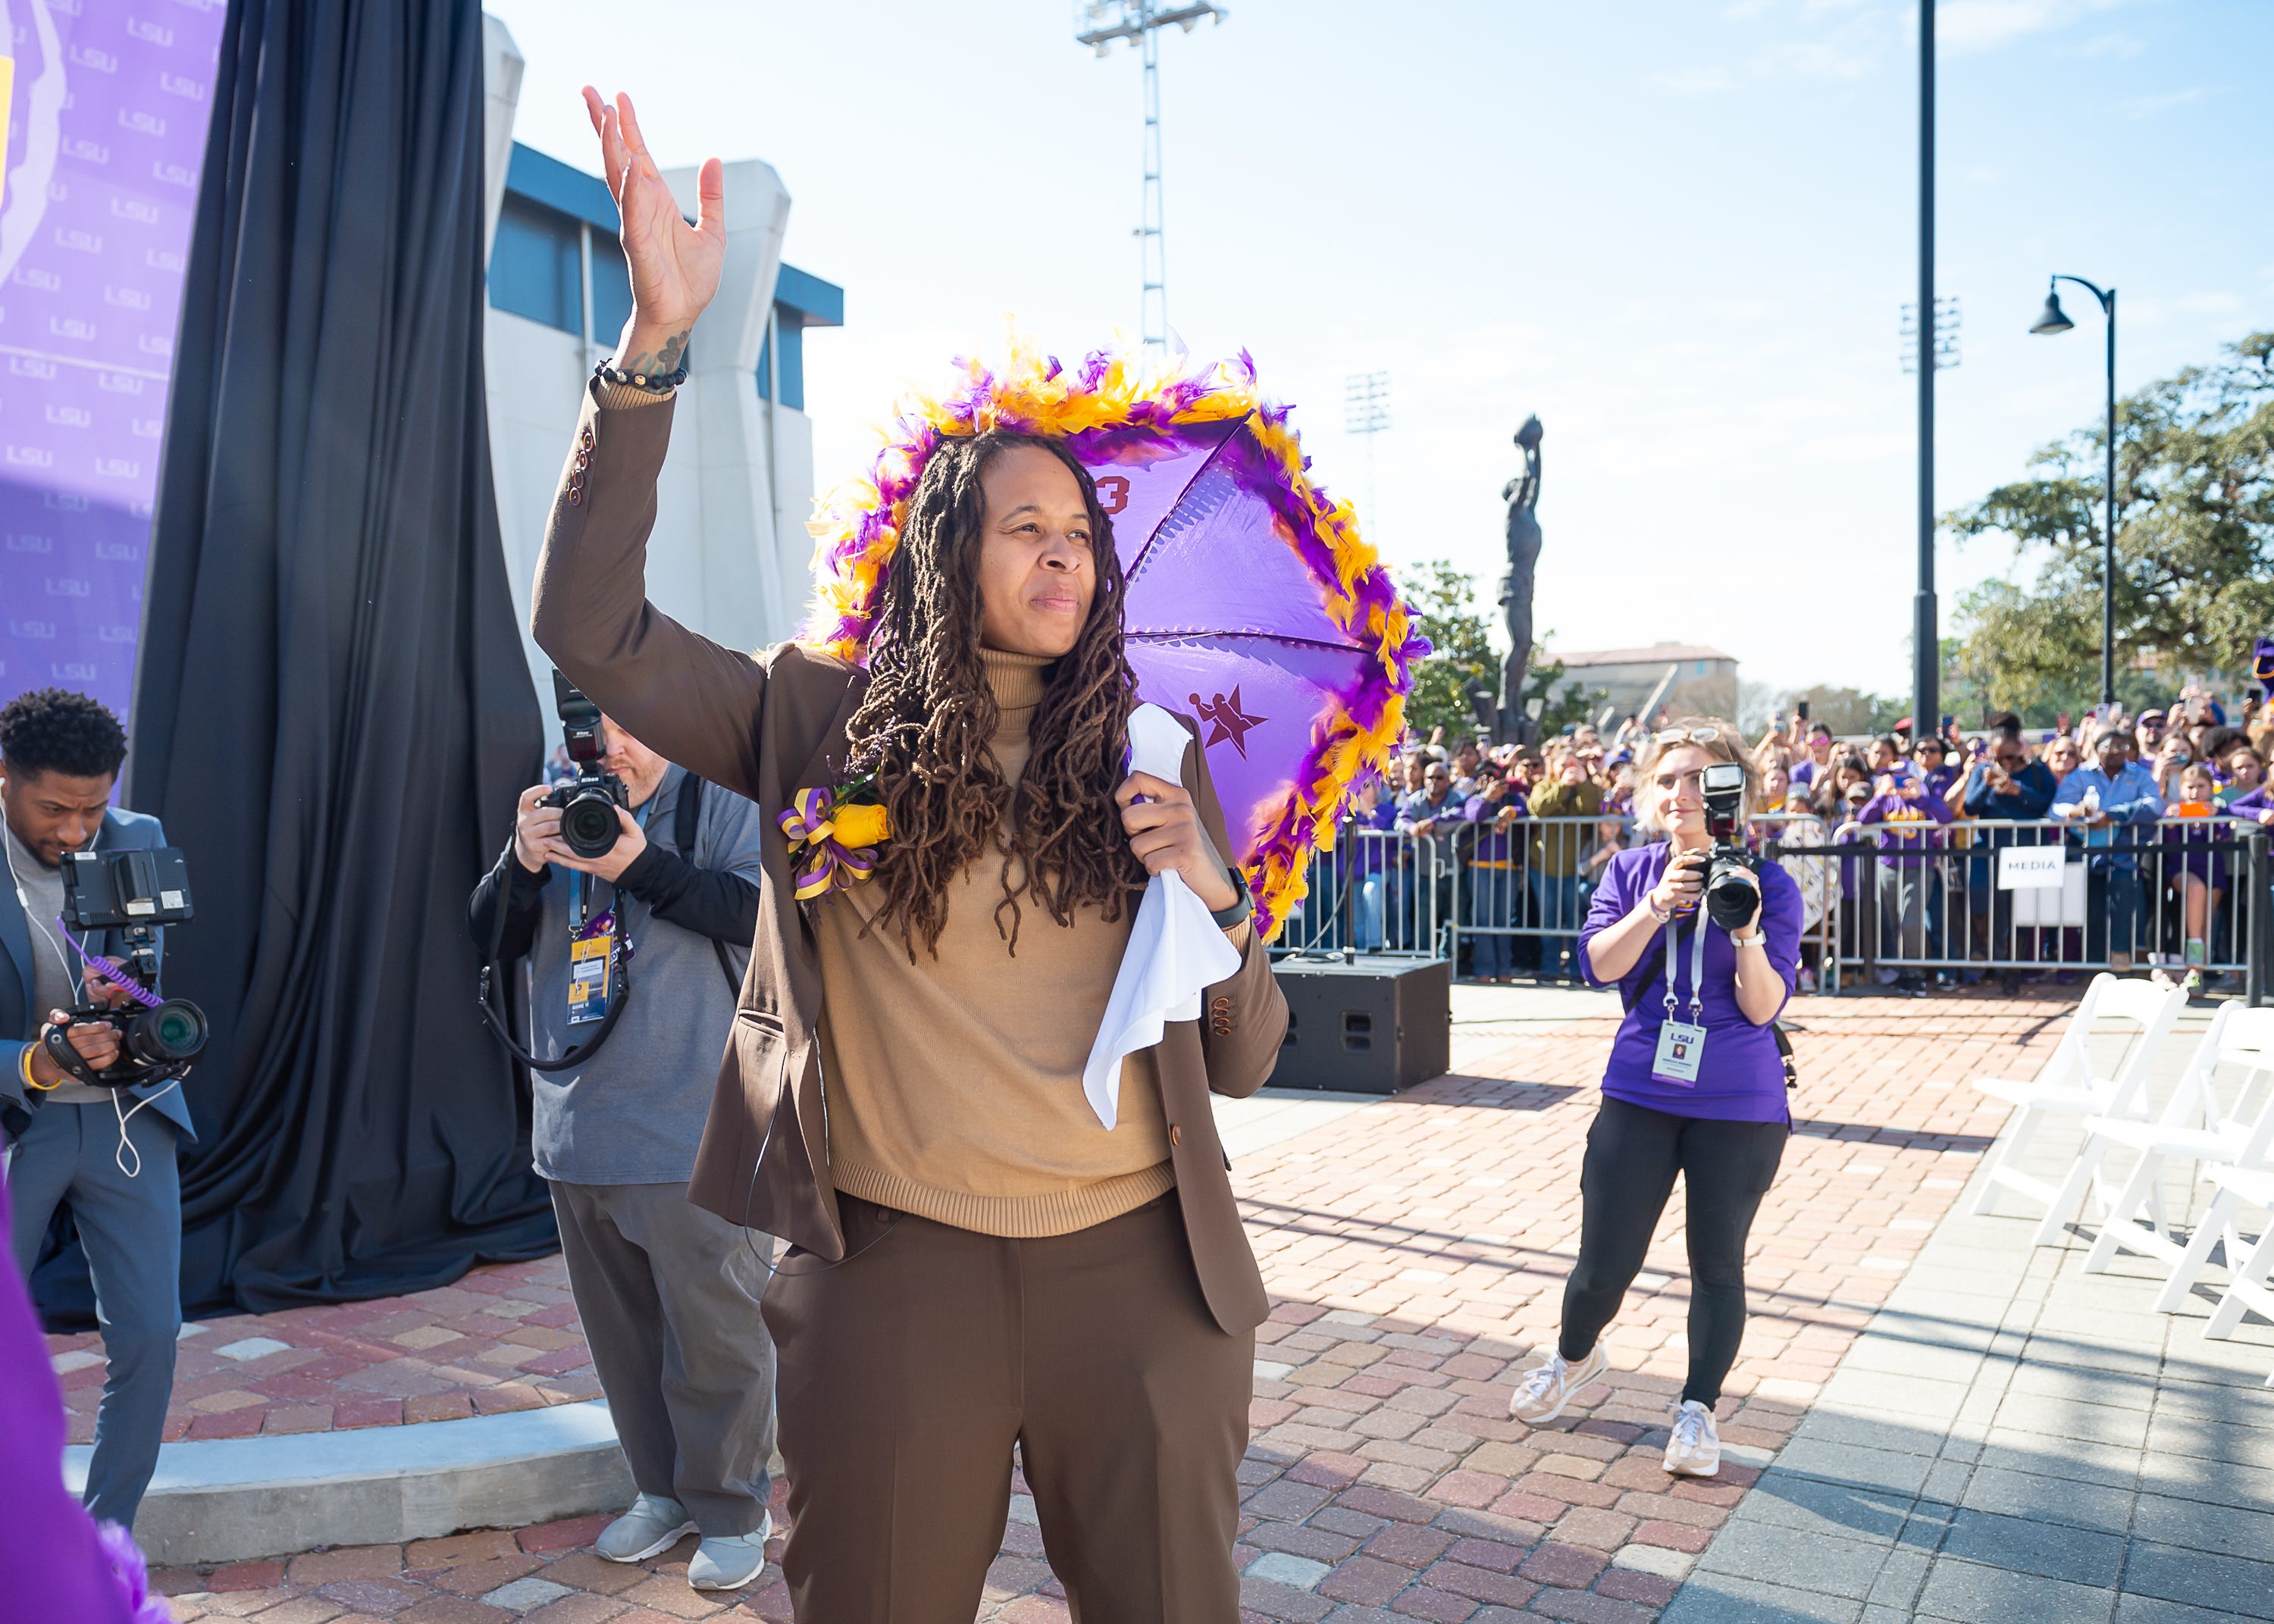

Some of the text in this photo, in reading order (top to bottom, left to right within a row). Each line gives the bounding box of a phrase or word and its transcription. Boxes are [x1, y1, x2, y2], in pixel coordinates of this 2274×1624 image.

[127, 16, 174, 47] LSU
[70, 44, 117, 74] LSU
[160, 71, 205, 102] LSU
[118, 107, 167, 137] LSU
[61, 135, 110, 164] LSU
[153, 160, 197, 188] LSU
[111, 196, 158, 224] LSU
[55, 227, 102, 254] LSU
[13, 265, 61, 293] LSU
[104, 284, 151, 311] LSU
[49, 314, 96, 341] LSU
[138, 333, 172, 357] LS
[9, 355, 57, 380] LSU
[99, 371, 143, 396] LSU
[45, 404, 92, 428] LSU
[131, 418, 162, 438] LS
[6, 443, 53, 468] LSU
[95, 457, 140, 478] LSU
[43, 491, 89, 512] LSU
[6, 533, 53, 554] LSU
[95, 540, 139, 562] LSU
[45, 577, 90, 597] LSU
[9, 618, 56, 640] LSU
[50, 662, 96, 681] LSU
[2009, 860, 2056, 870] MEDIA
[1671, 1033, 1694, 1044] LSU
